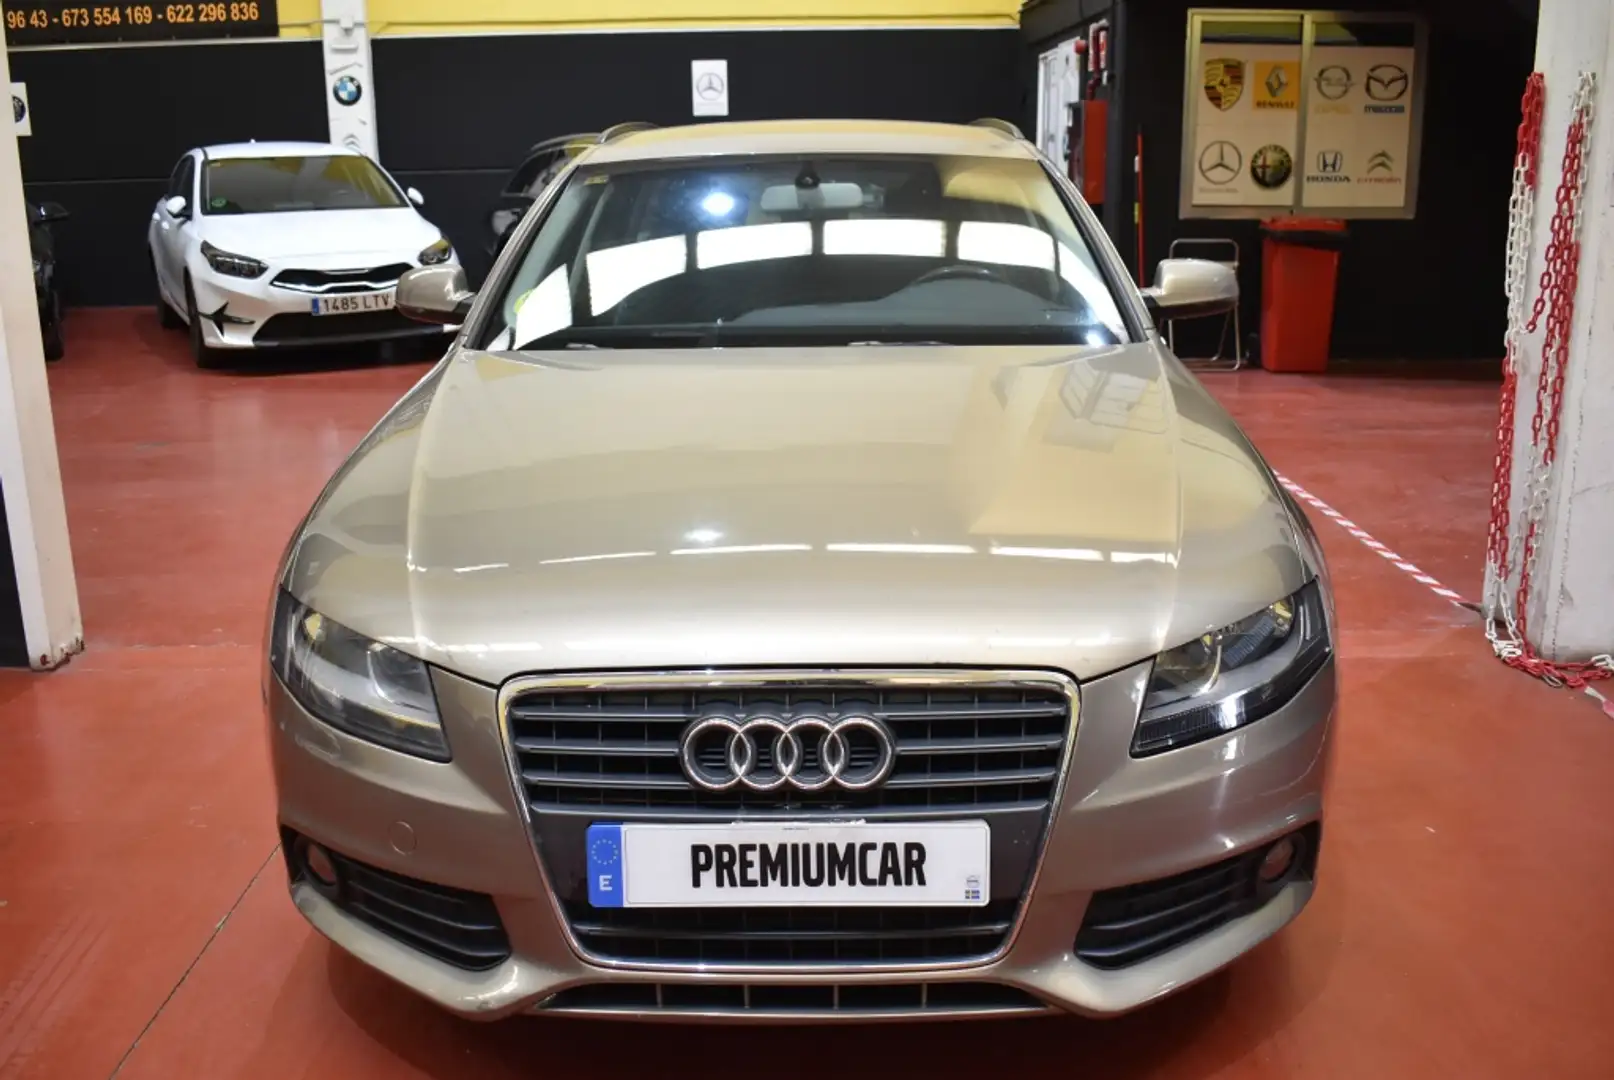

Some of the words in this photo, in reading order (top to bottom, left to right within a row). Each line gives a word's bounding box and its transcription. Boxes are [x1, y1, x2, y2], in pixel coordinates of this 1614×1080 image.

[7, 10, 26, 28] 96
[30, 9, 48, 28] 43
[62, 8, 90, 27] 673
[94, 7, 121, 26] 554
[125, 6, 152, 25] 169
[166, 4, 194, 23] 622
[199, 3, 226, 22] 296
[230, 2, 259, 21] 836
[1306, 175, 1351, 184] HONDA
[324, 296, 359, 312] 1485
[363, 294, 389, 309] LTV
[690, 842, 927, 888] PREMIUMCAR
[599, 874, 613, 891] E
